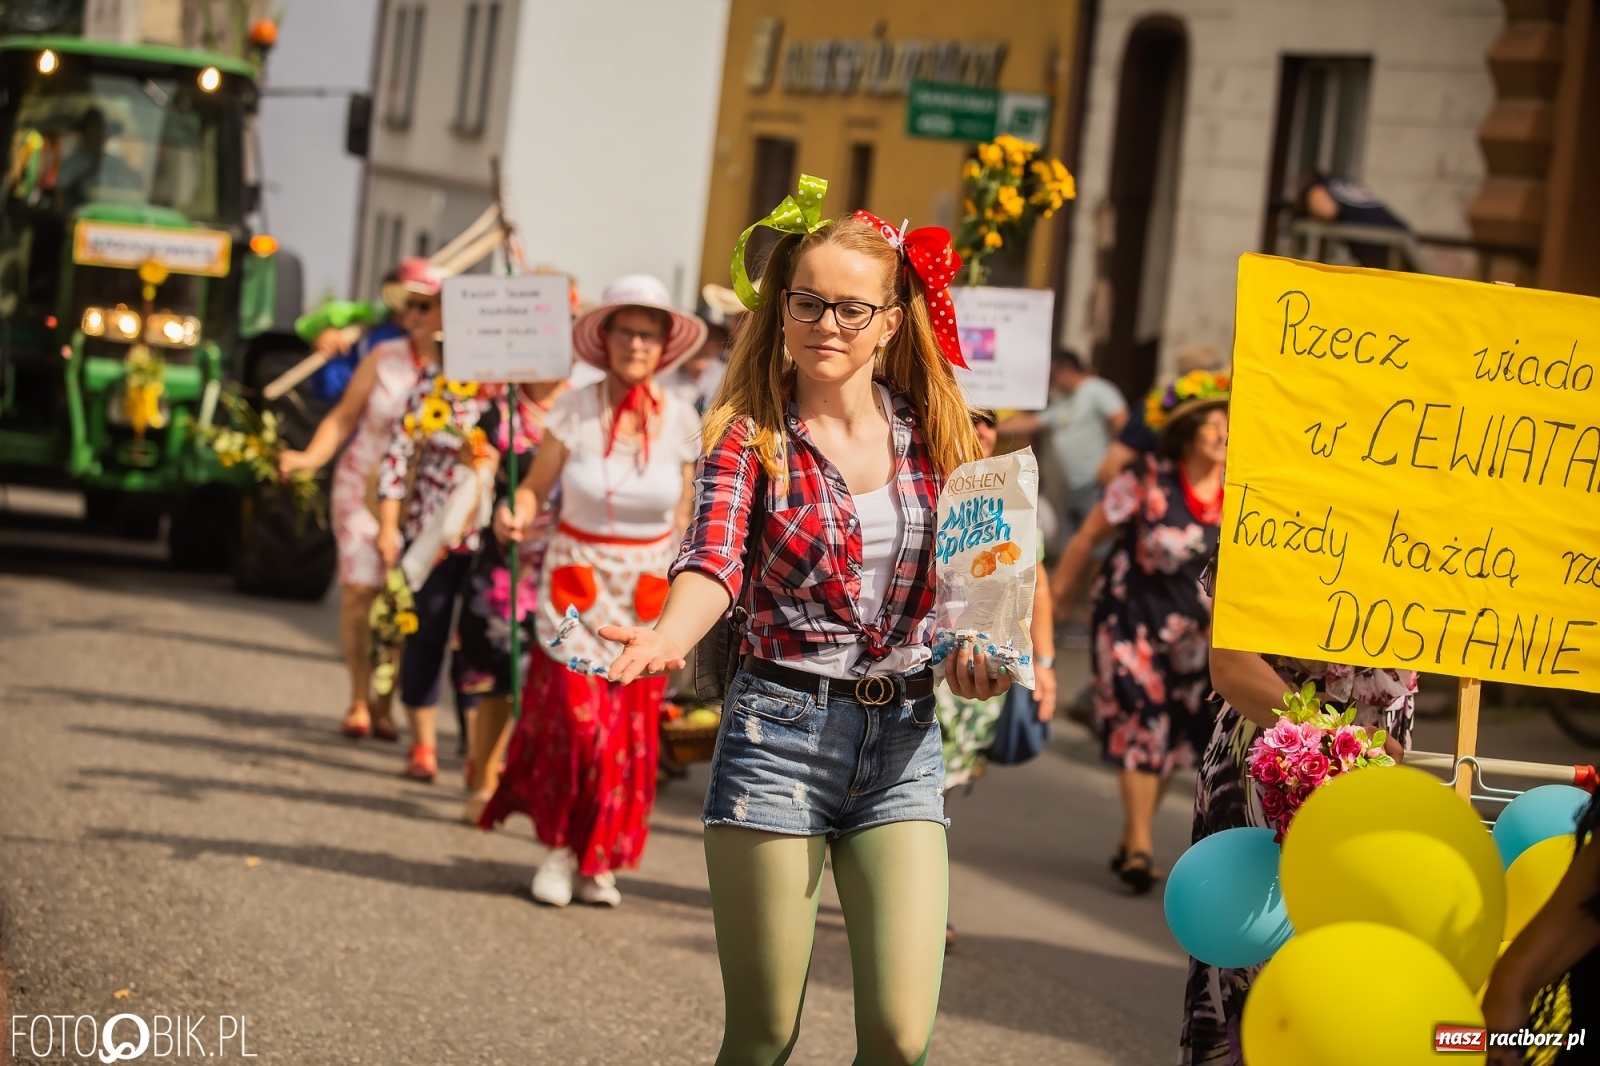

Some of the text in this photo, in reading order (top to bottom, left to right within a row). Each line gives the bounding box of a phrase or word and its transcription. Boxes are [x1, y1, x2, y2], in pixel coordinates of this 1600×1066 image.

[1277, 290, 1593, 391] Rzecz wiado
[947, 472, 1007, 496] ROSHEN
[1304, 399, 1600, 493] w LEWIATA
[936, 517, 1011, 564] Splash
[942, 495, 1004, 531] Milky
[1233, 483, 1348, 585] każdy
[1383, 509, 1519, 588] każdą
[1318, 590, 1598, 675] DOSTANIE
